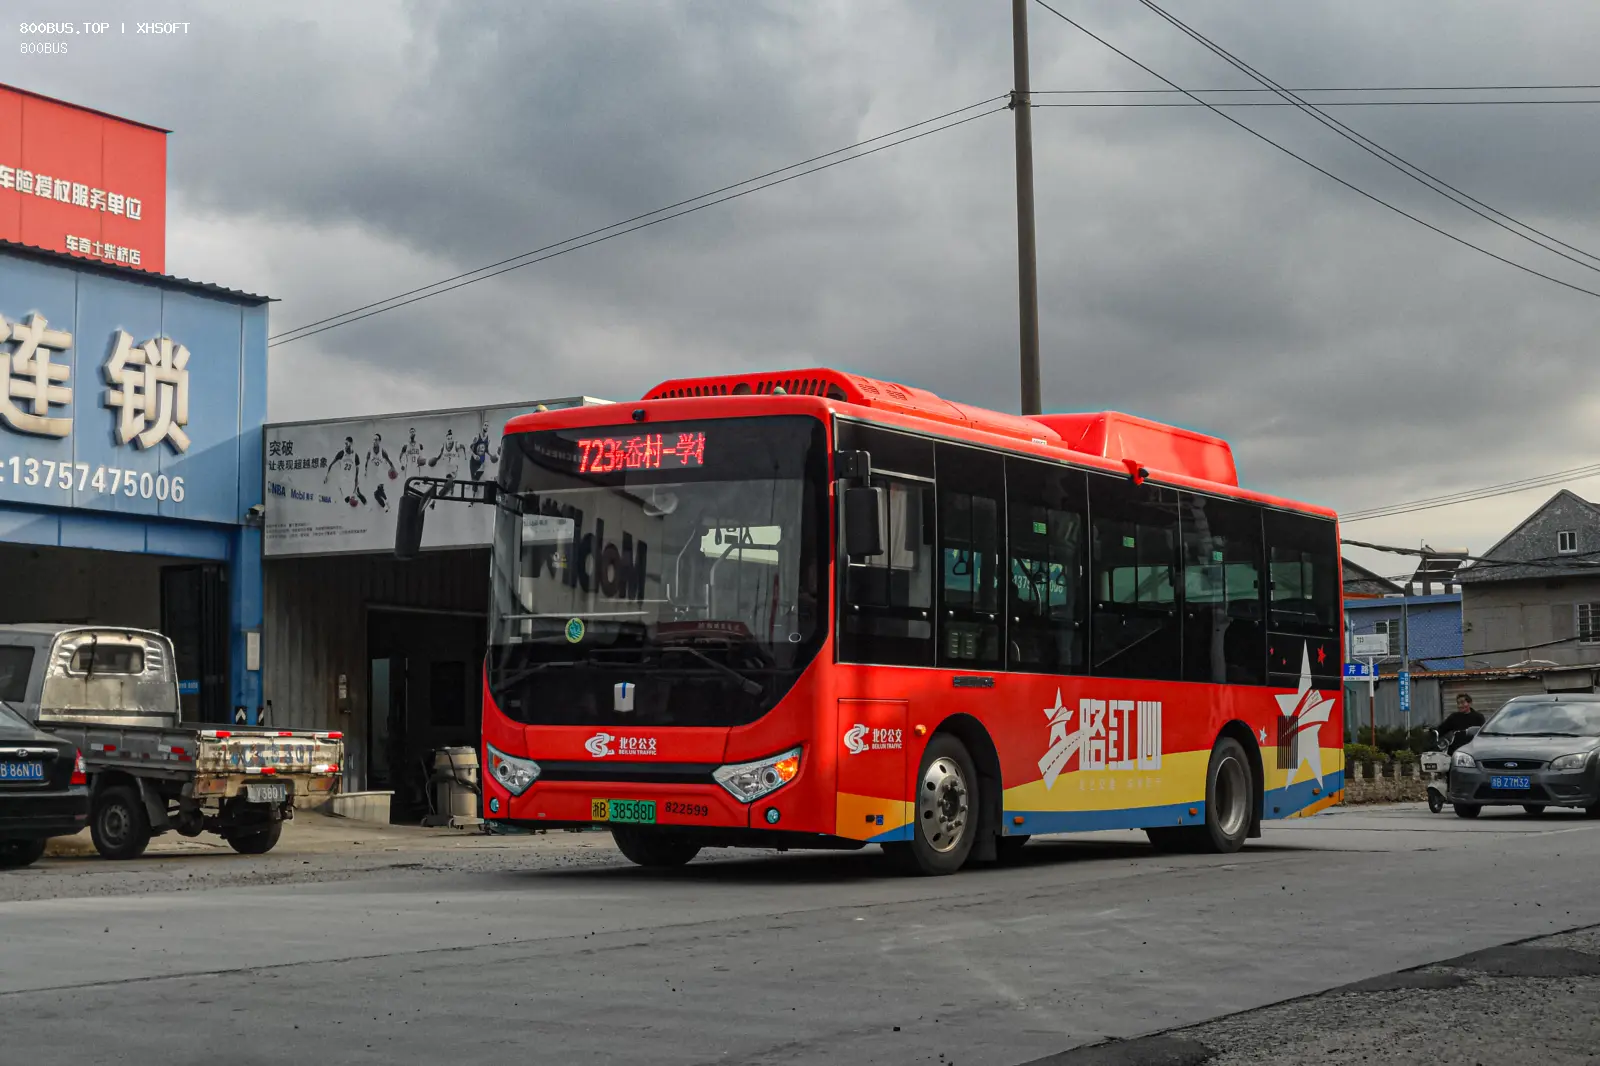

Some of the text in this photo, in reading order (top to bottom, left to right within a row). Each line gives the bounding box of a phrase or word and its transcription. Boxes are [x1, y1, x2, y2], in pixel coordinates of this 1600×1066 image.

[0, 165, 142, 221] 车险授权服务单位
[65, 234, 141, 266] 车奇士柴桥店
[269, 440, 294, 457] 突破
[578, 438, 615, 473] 723
[268, 457, 328, 471] 让表现超越想象
[271, 482, 286, 497] NBA
[619, 736, 657, 750] 北仑公交
[665, 801, 709, 817] 822599
